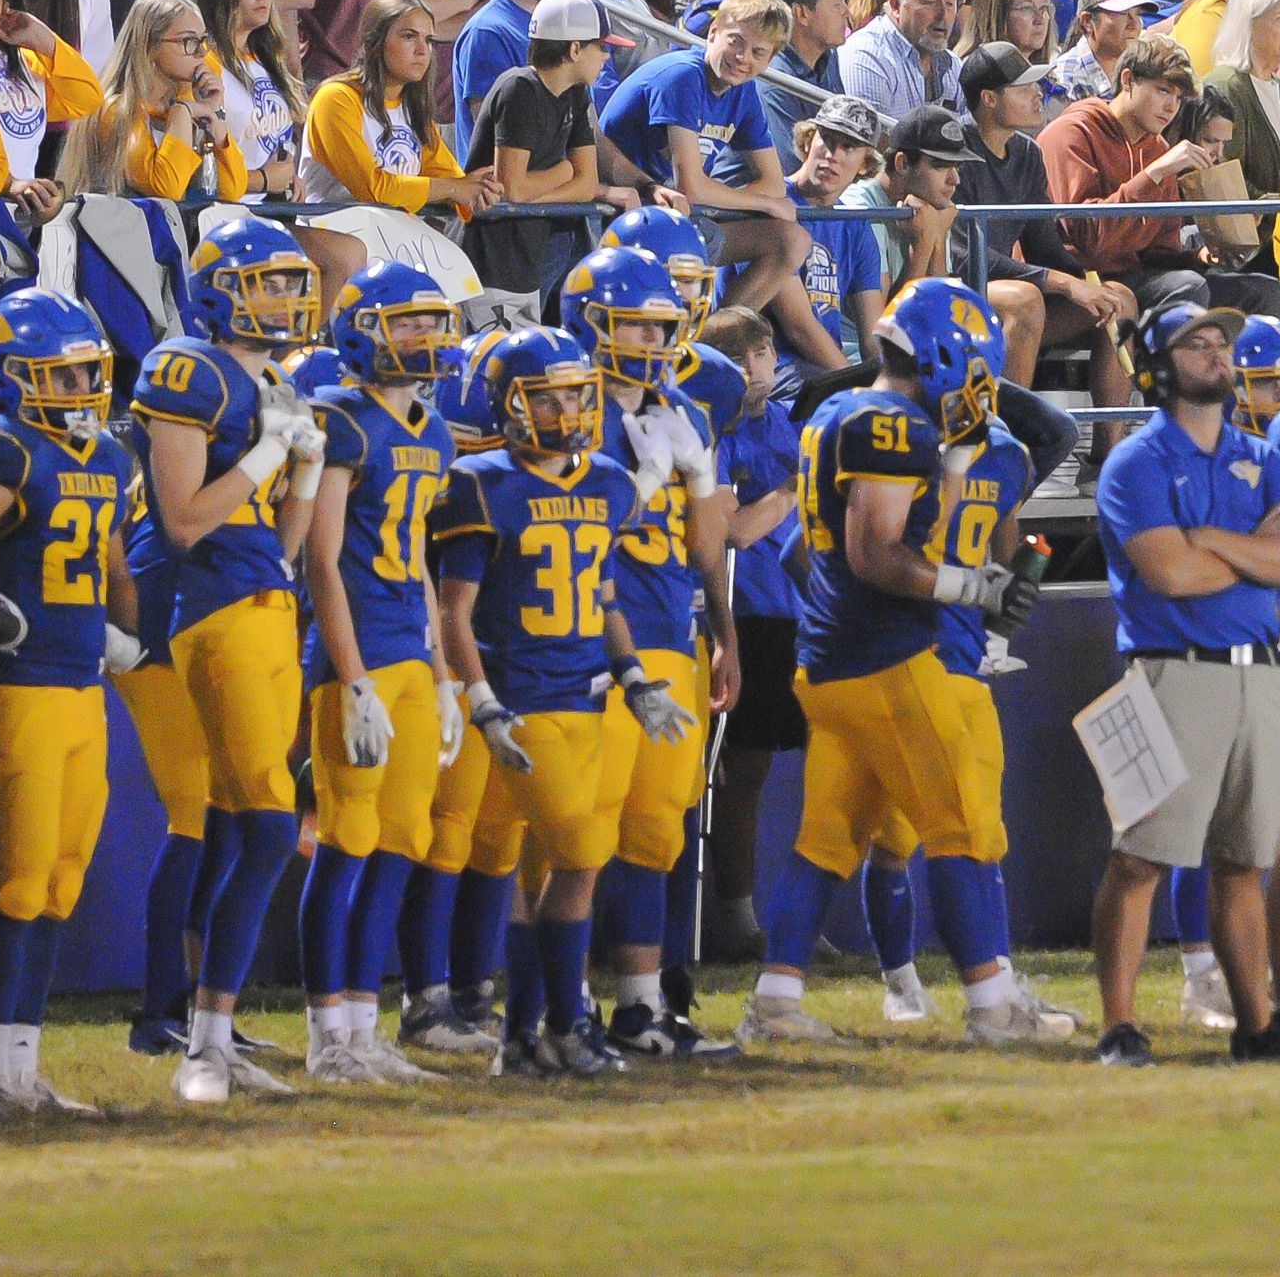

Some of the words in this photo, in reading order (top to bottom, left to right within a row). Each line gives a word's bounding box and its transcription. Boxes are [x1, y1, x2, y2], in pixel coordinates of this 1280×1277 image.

[150, 353, 197, 393] 10
[871, 414, 911, 453] 51
[56, 472, 118, 500] INDIANS
[960, 478, 1001, 503] IANS
[527, 496, 609, 523] INDIANS
[519, 522, 613, 637] 32
